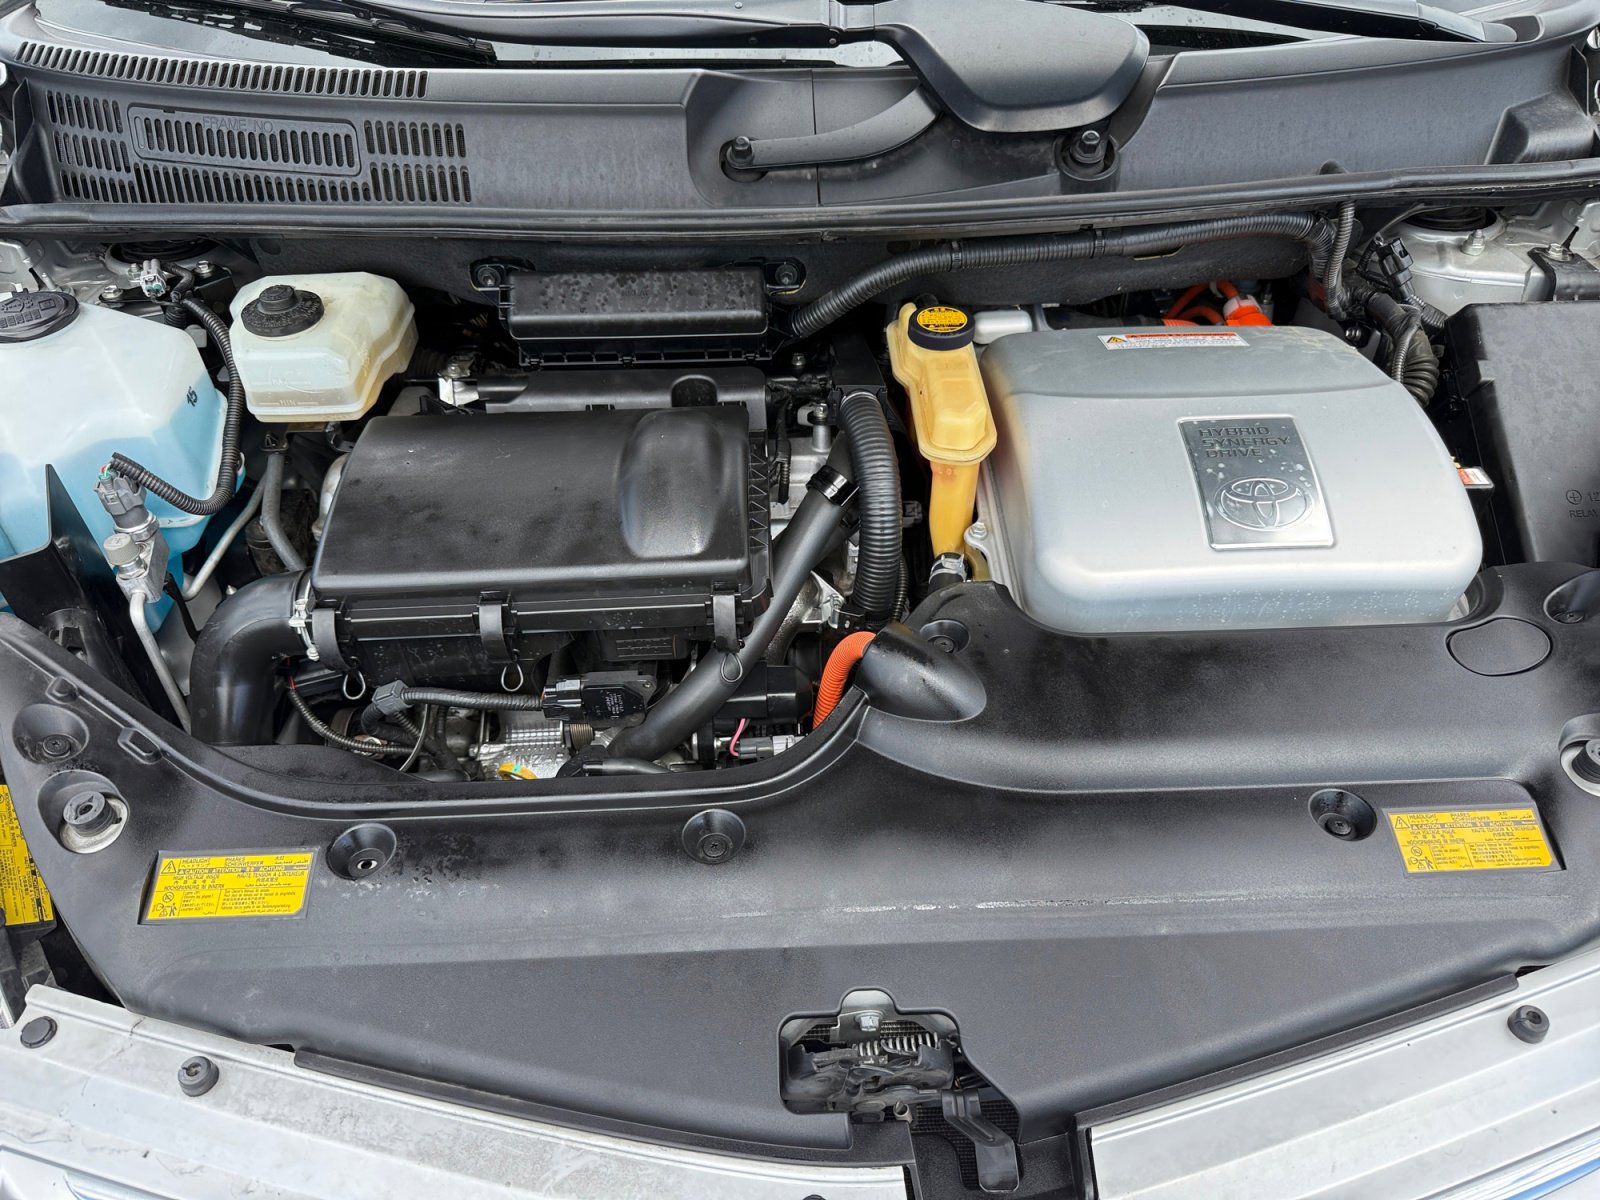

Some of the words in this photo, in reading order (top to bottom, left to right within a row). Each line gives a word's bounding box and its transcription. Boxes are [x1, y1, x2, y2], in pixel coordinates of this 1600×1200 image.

[202, 115, 248, 132] FRAME
[1198, 426, 1271, 437] HYBRID
[1202, 436, 1290, 448] SYNERGY
[1205, 448, 1263, 458] DRIVE
